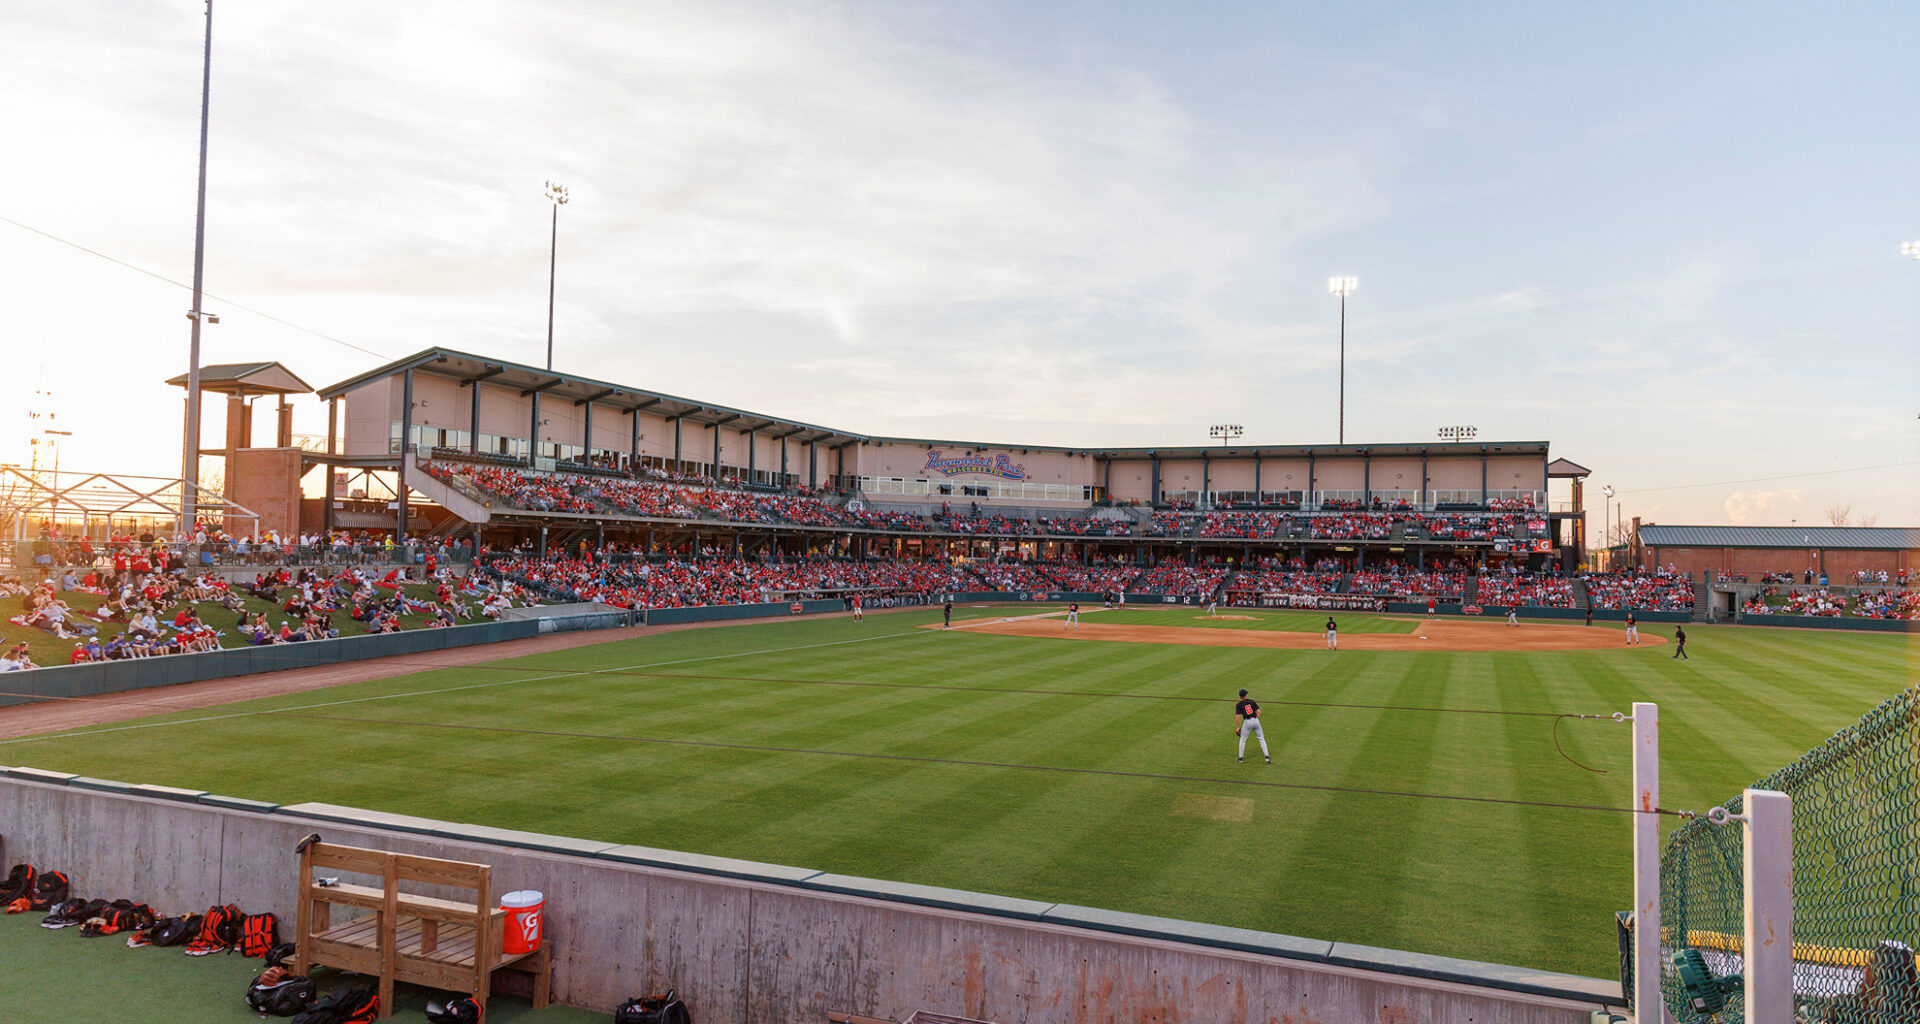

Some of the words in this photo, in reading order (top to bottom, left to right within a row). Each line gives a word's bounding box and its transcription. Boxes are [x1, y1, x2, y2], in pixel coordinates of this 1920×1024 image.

[926, 451, 993, 469] Haymarket
[995, 454, 1024, 475] Park
[946, 466, 987, 474] WELCOMES
[1541, 541, 1549, 549] G
[1245, 704, 1253, 715] 6
[526, 914, 537, 928] G
